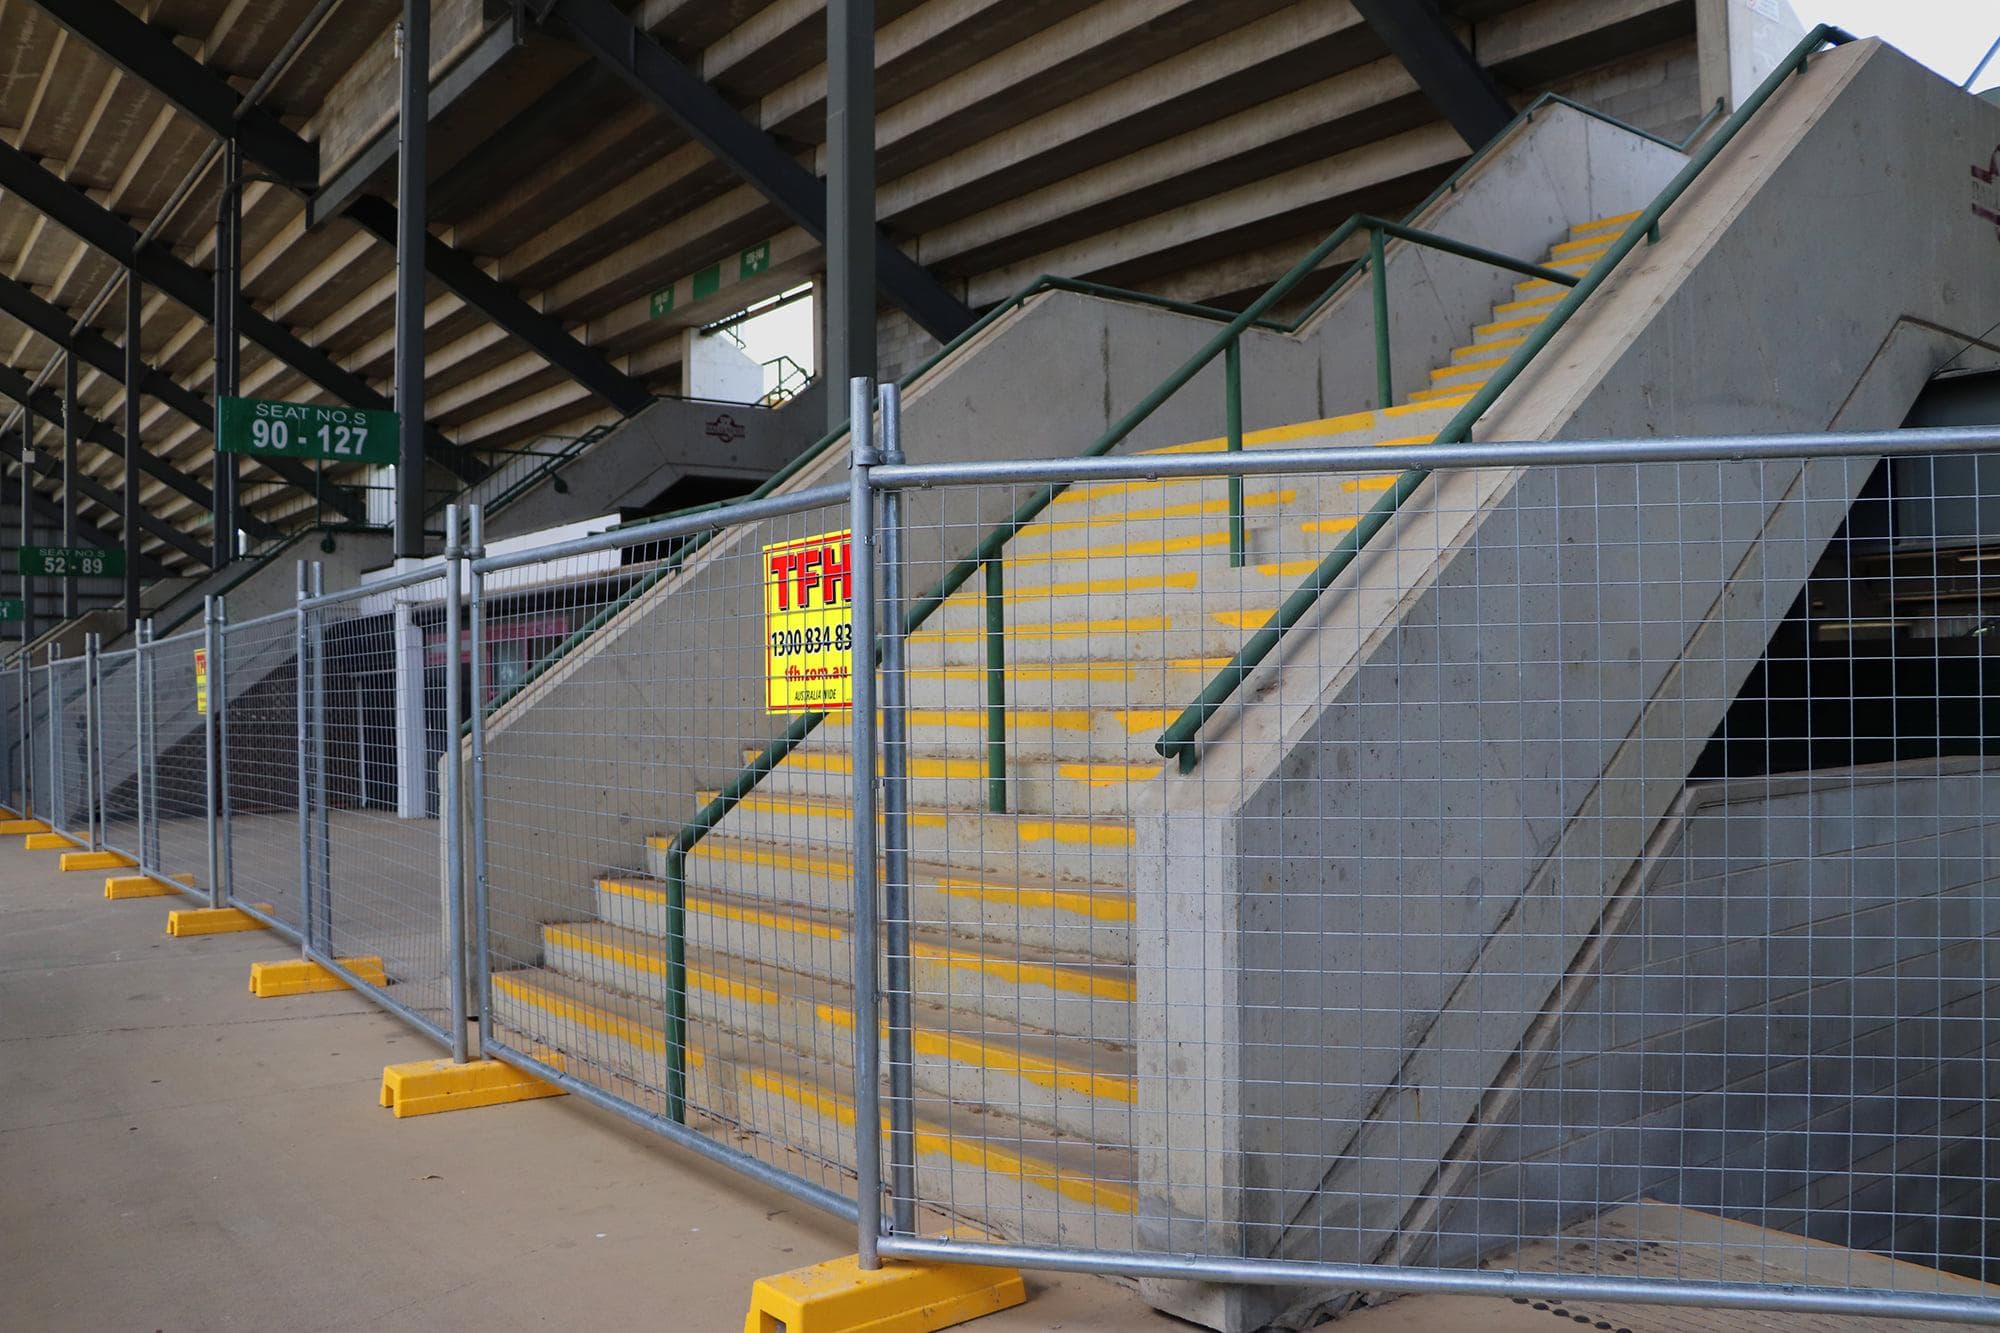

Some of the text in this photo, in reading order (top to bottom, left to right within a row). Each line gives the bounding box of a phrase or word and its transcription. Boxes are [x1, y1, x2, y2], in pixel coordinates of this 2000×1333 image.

[255, 402, 367, 425] SEAT NO.S
[252, 418, 288, 449] 90
[317, 424, 368, 455] 127
[44, 556, 66, 574] 52
[82, 558, 103, 574] 89
[770, 543, 852, 611] TFH
[772, 623, 852, 657] 1300 834 83
[794, 690, 822, 701] AUSTRALIA
